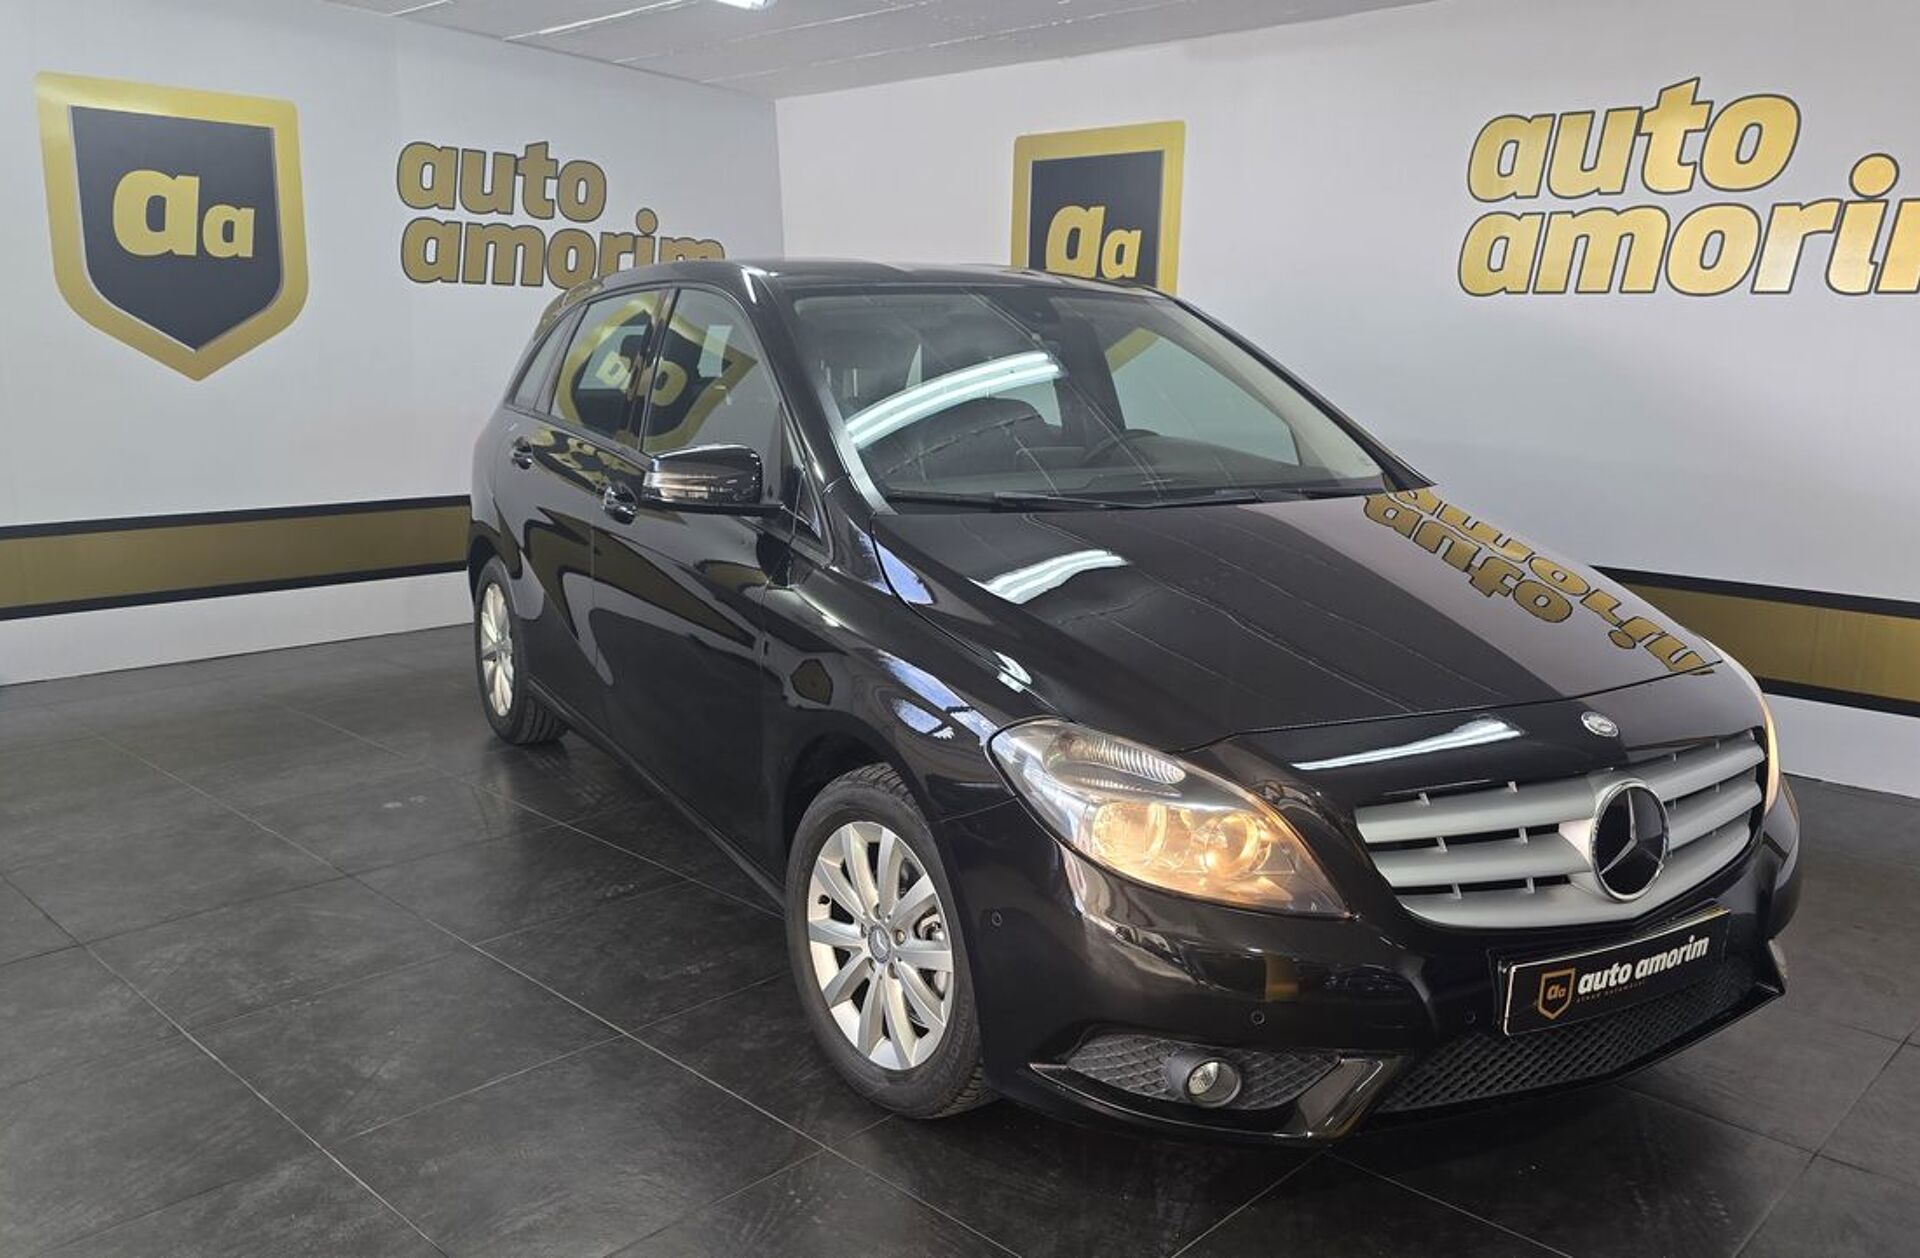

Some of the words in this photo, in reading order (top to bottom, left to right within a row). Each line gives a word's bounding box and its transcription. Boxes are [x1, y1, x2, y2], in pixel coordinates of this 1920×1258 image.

[397, 141, 607, 223] auto
[1467, 77, 1802, 203] auto
[113, 168, 256, 259] aa
[1577, 961, 1633, 995] auto
[1635, 934, 1710, 979] amorim
